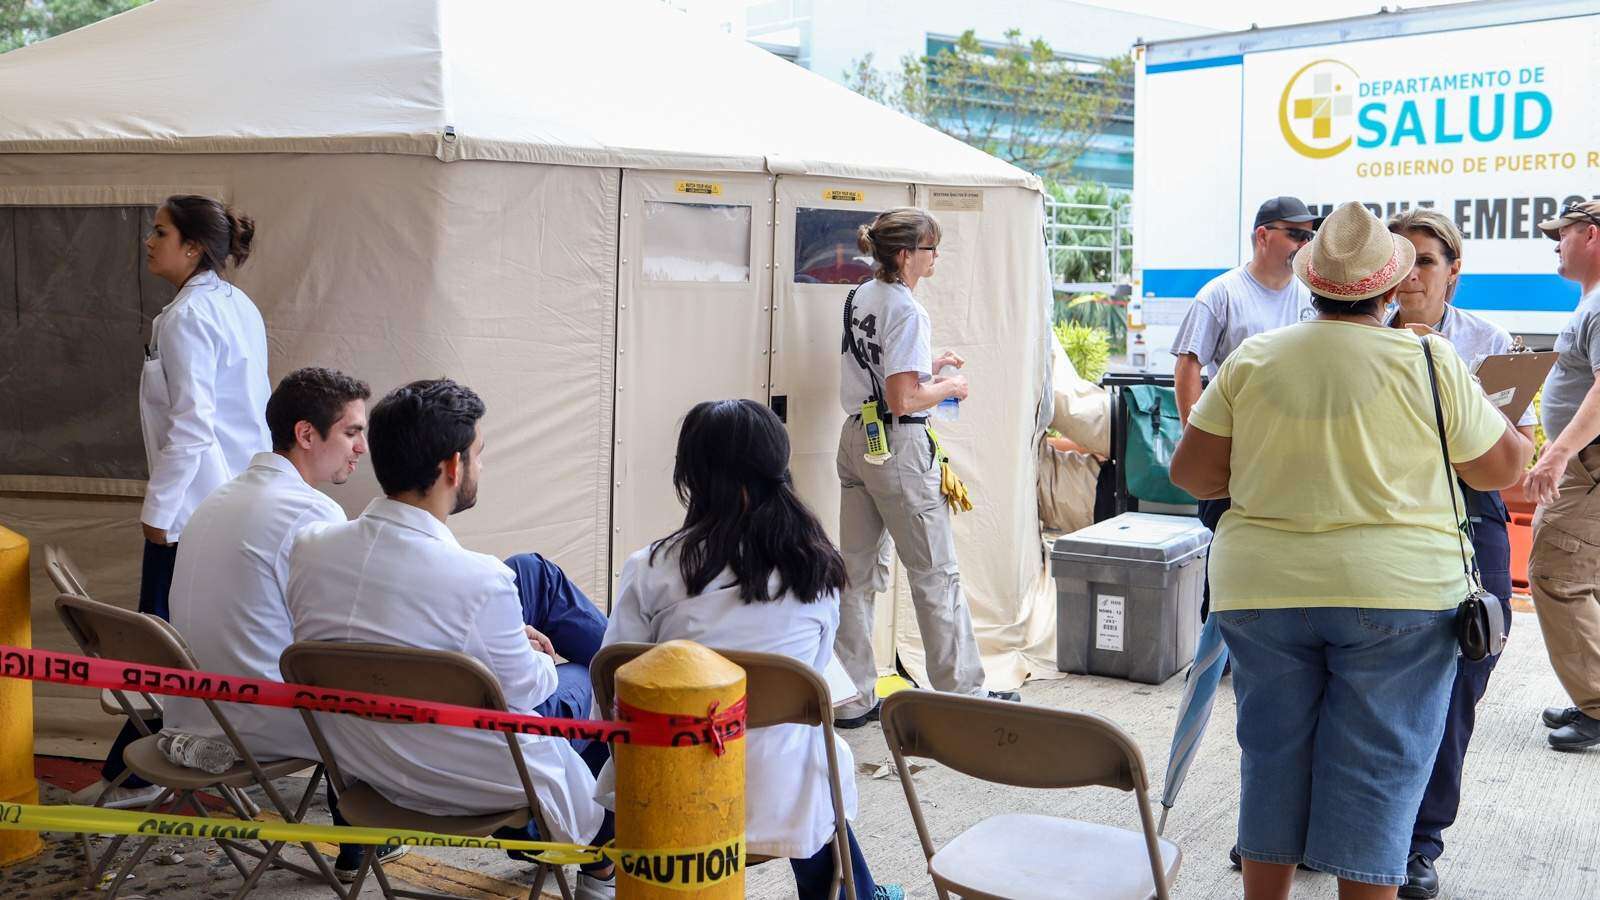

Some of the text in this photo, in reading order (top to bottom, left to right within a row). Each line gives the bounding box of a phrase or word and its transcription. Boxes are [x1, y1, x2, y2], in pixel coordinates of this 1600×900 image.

[1358, 67, 1545, 97] DEPARTAMENTO DE
[1357, 91, 1553, 149] SALUD
[1356, 151, 1600, 178] GOBIERNO DE PUERTO R
[1454, 195, 1600, 239] EMER
[621, 842, 740, 884] CAUTION
